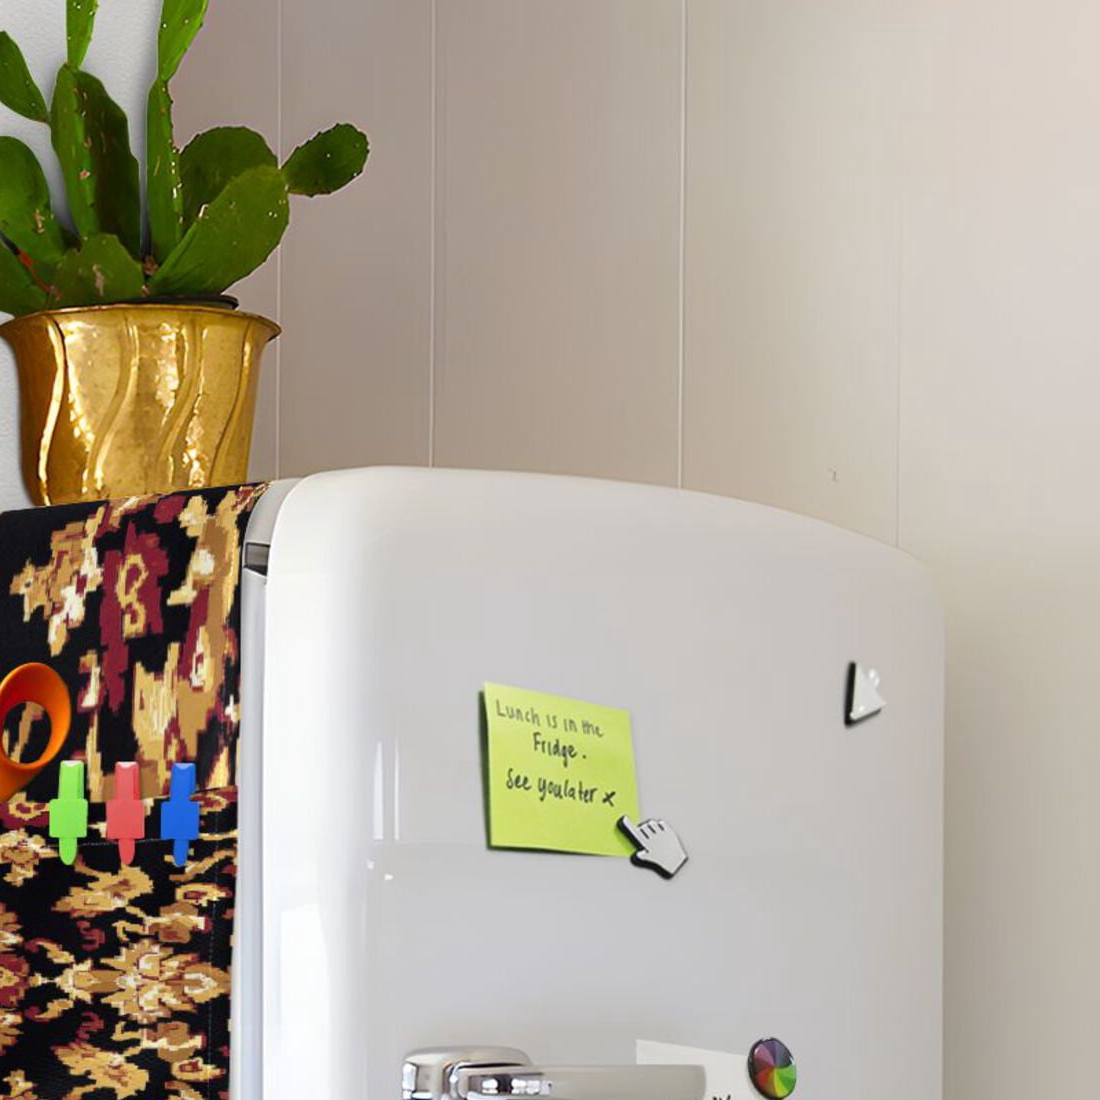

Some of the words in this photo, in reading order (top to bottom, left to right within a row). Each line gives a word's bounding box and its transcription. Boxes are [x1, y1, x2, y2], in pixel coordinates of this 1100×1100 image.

[496, 699, 540, 727] Lunch
[563, 718, 577, 733] in
[582, 720, 604, 737] the
[506, 768, 532, 790] See
